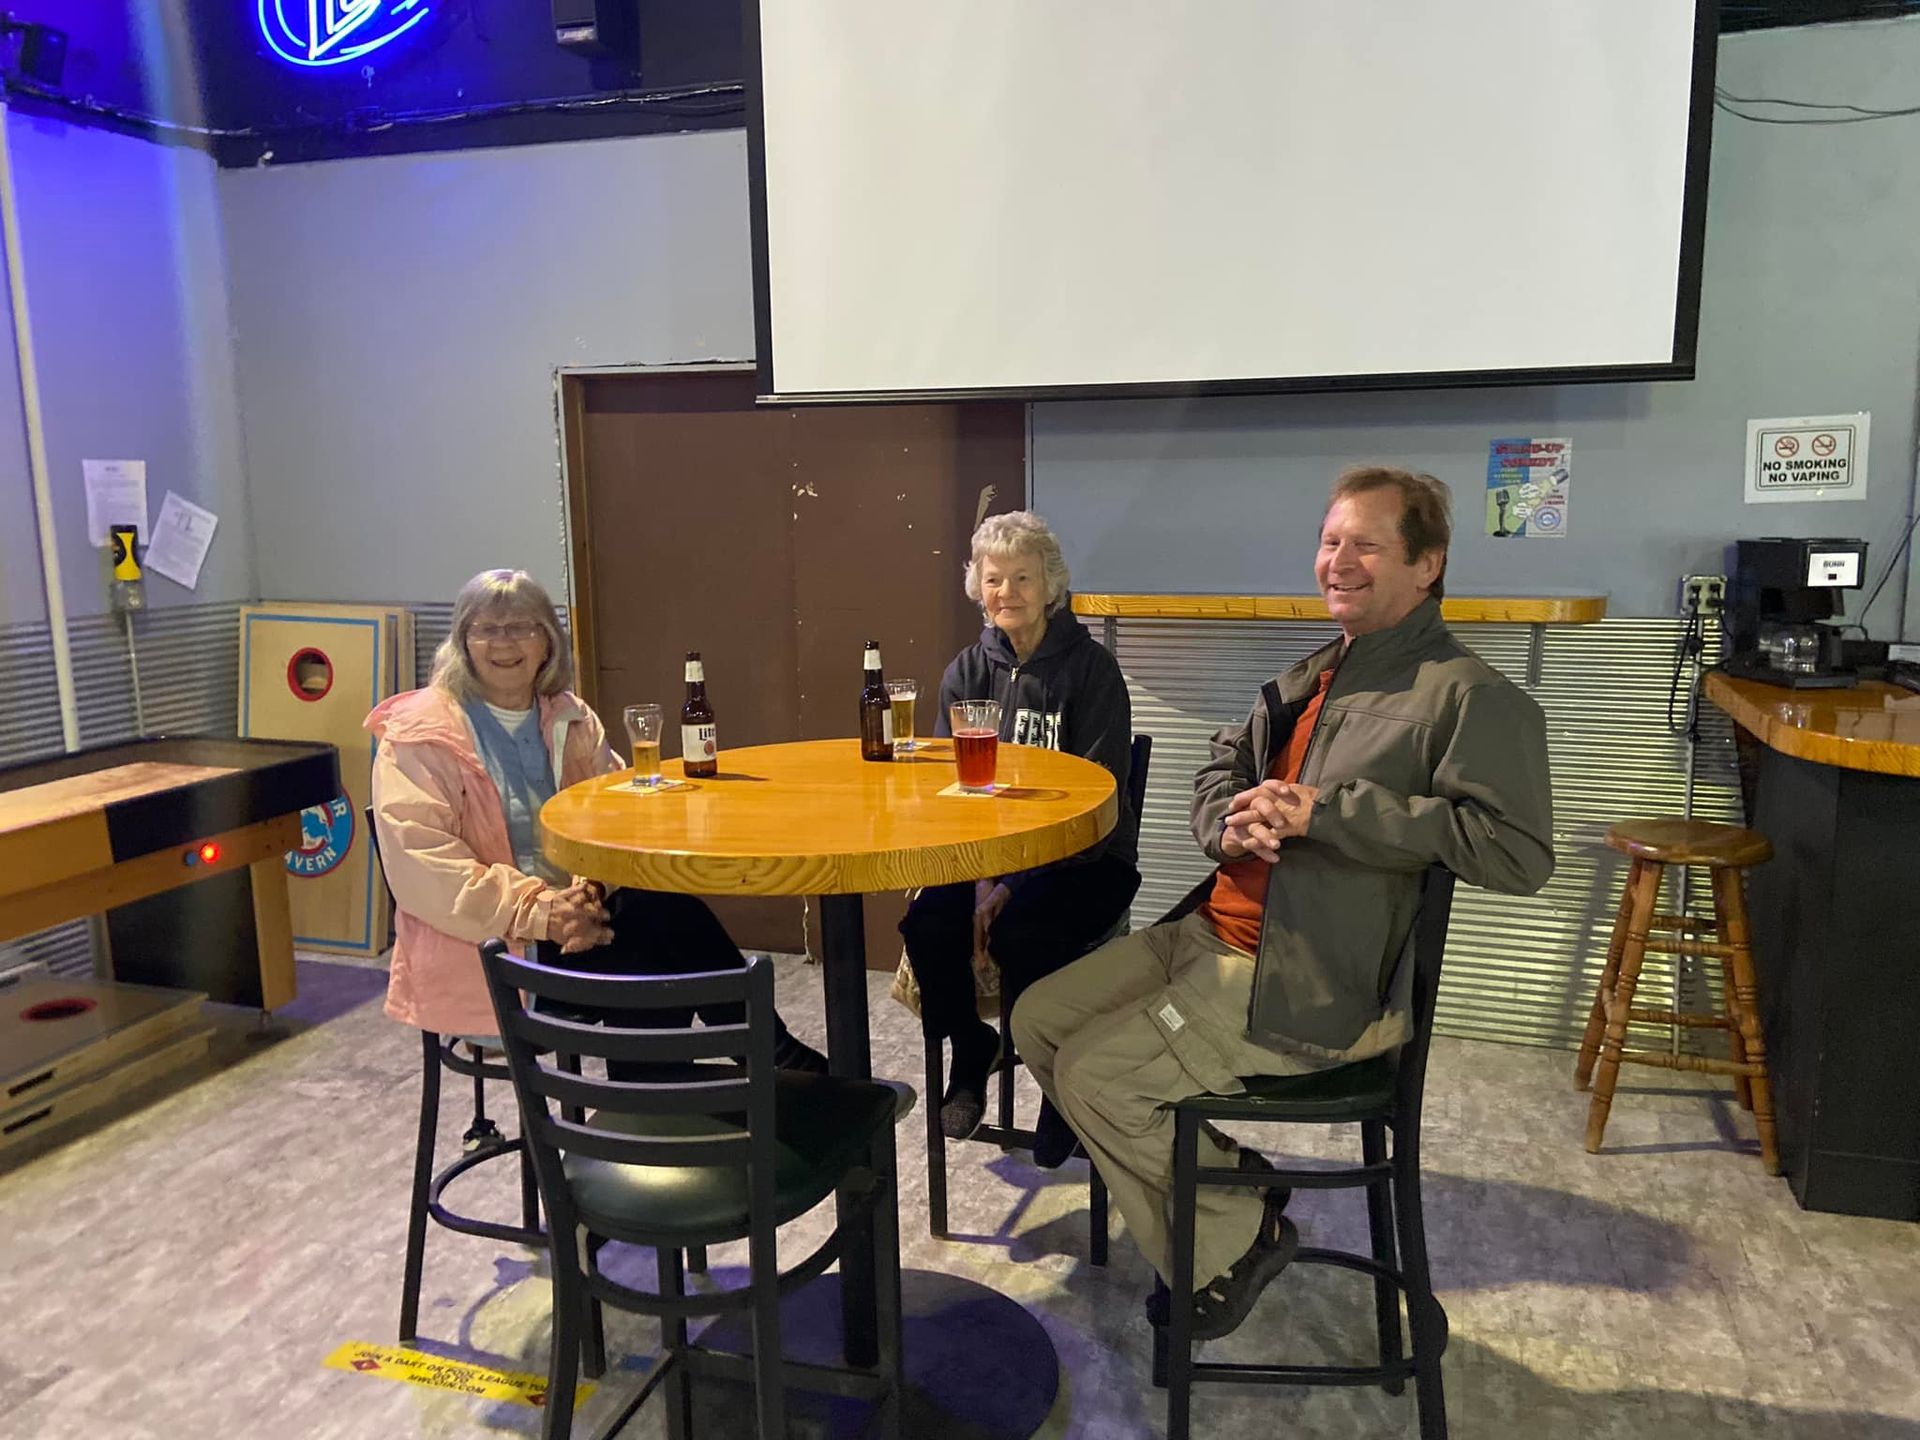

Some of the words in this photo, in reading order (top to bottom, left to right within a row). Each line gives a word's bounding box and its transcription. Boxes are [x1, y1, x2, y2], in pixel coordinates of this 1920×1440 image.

[1762, 461, 1782, 471] NO
[1785, 458, 1847, 470] SMOKING
[1768, 472, 1787, 483] NO
[1791, 471, 1840, 482] VAPING
[283, 846, 337, 871] AVERN
[354, 1350, 384, 1360] JOIN
[394, 1358, 427, 1368] DART
[426, 1364, 445, 1373] OR
[445, 1367, 475, 1379] POOL
[478, 1374, 527, 1388] LEAGUE
